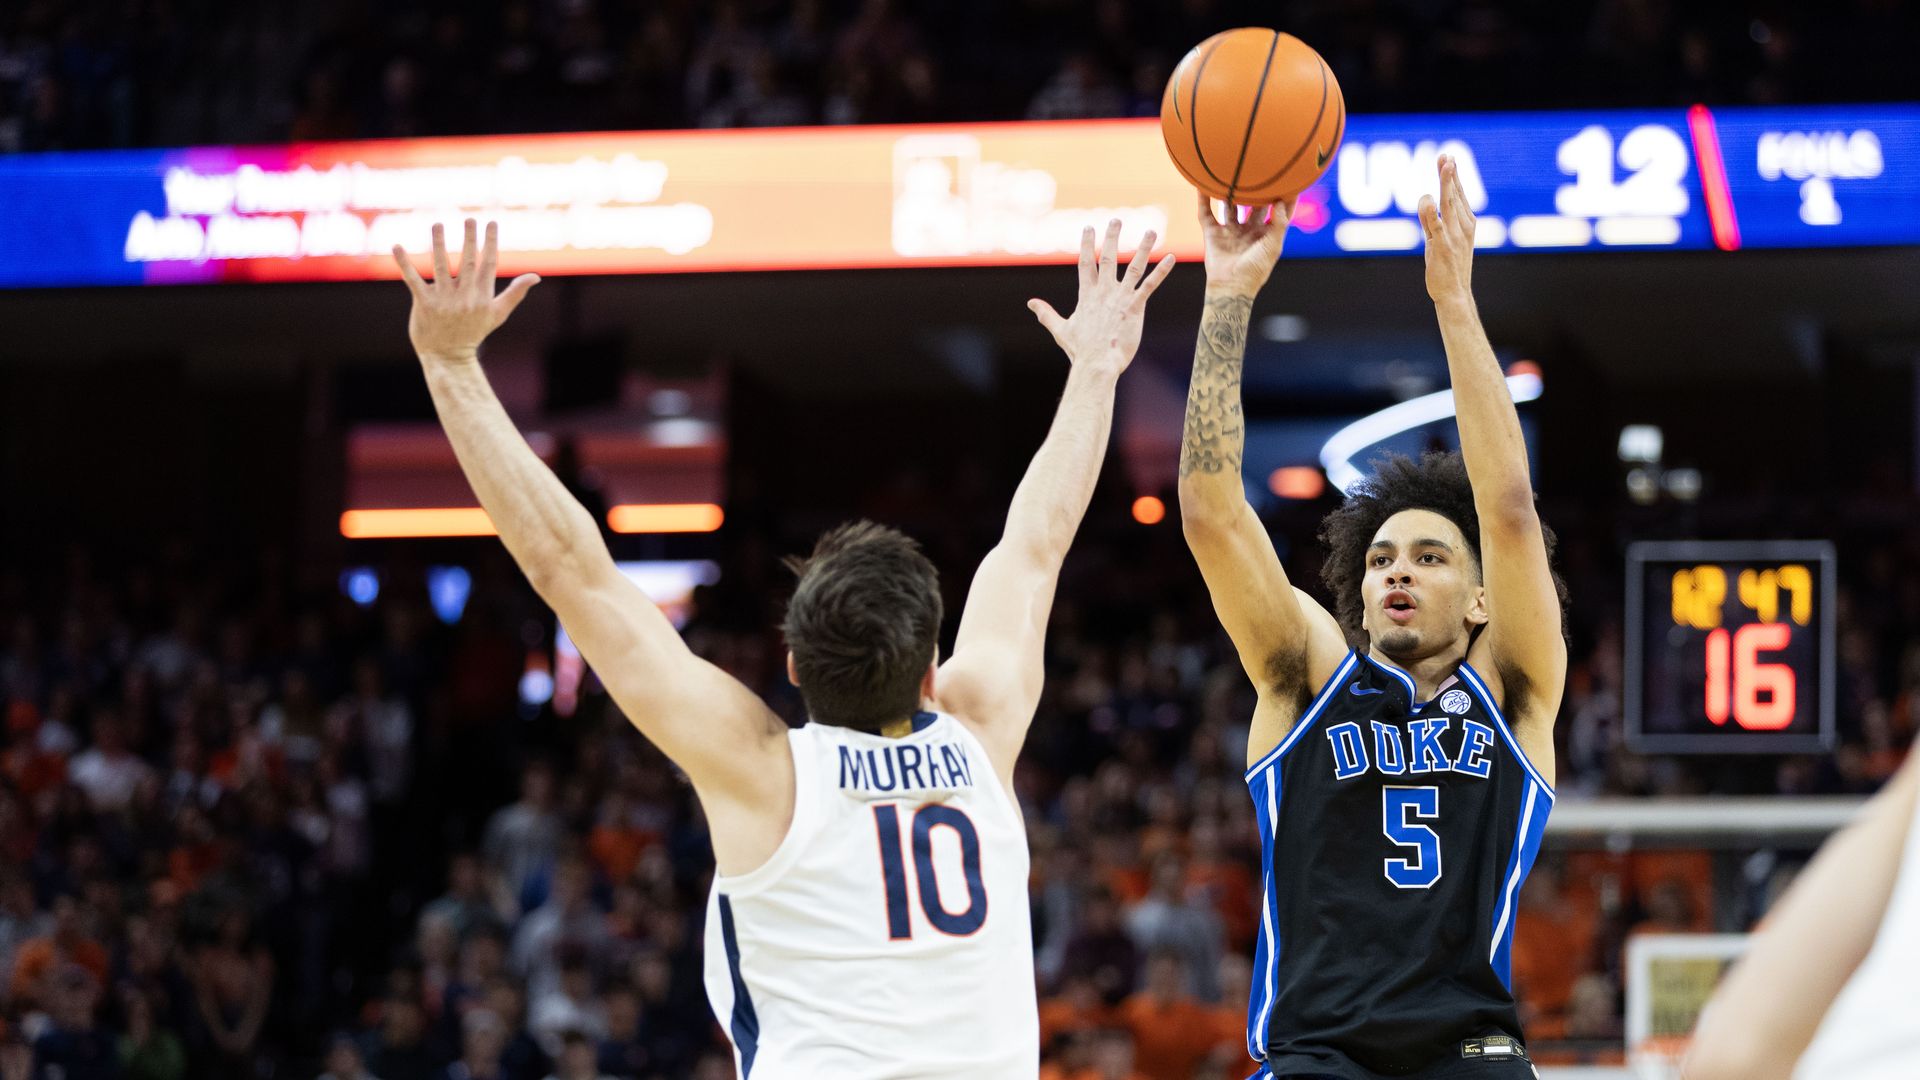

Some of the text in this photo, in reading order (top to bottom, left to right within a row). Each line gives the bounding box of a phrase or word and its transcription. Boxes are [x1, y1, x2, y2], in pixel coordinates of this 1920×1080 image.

[1555, 124, 1690, 218] 12
[1704, 622, 1797, 731] 16
[1325, 717, 1495, 780] DUKE
[872, 801, 988, 941] 10
[1382, 785, 1442, 888] 5
